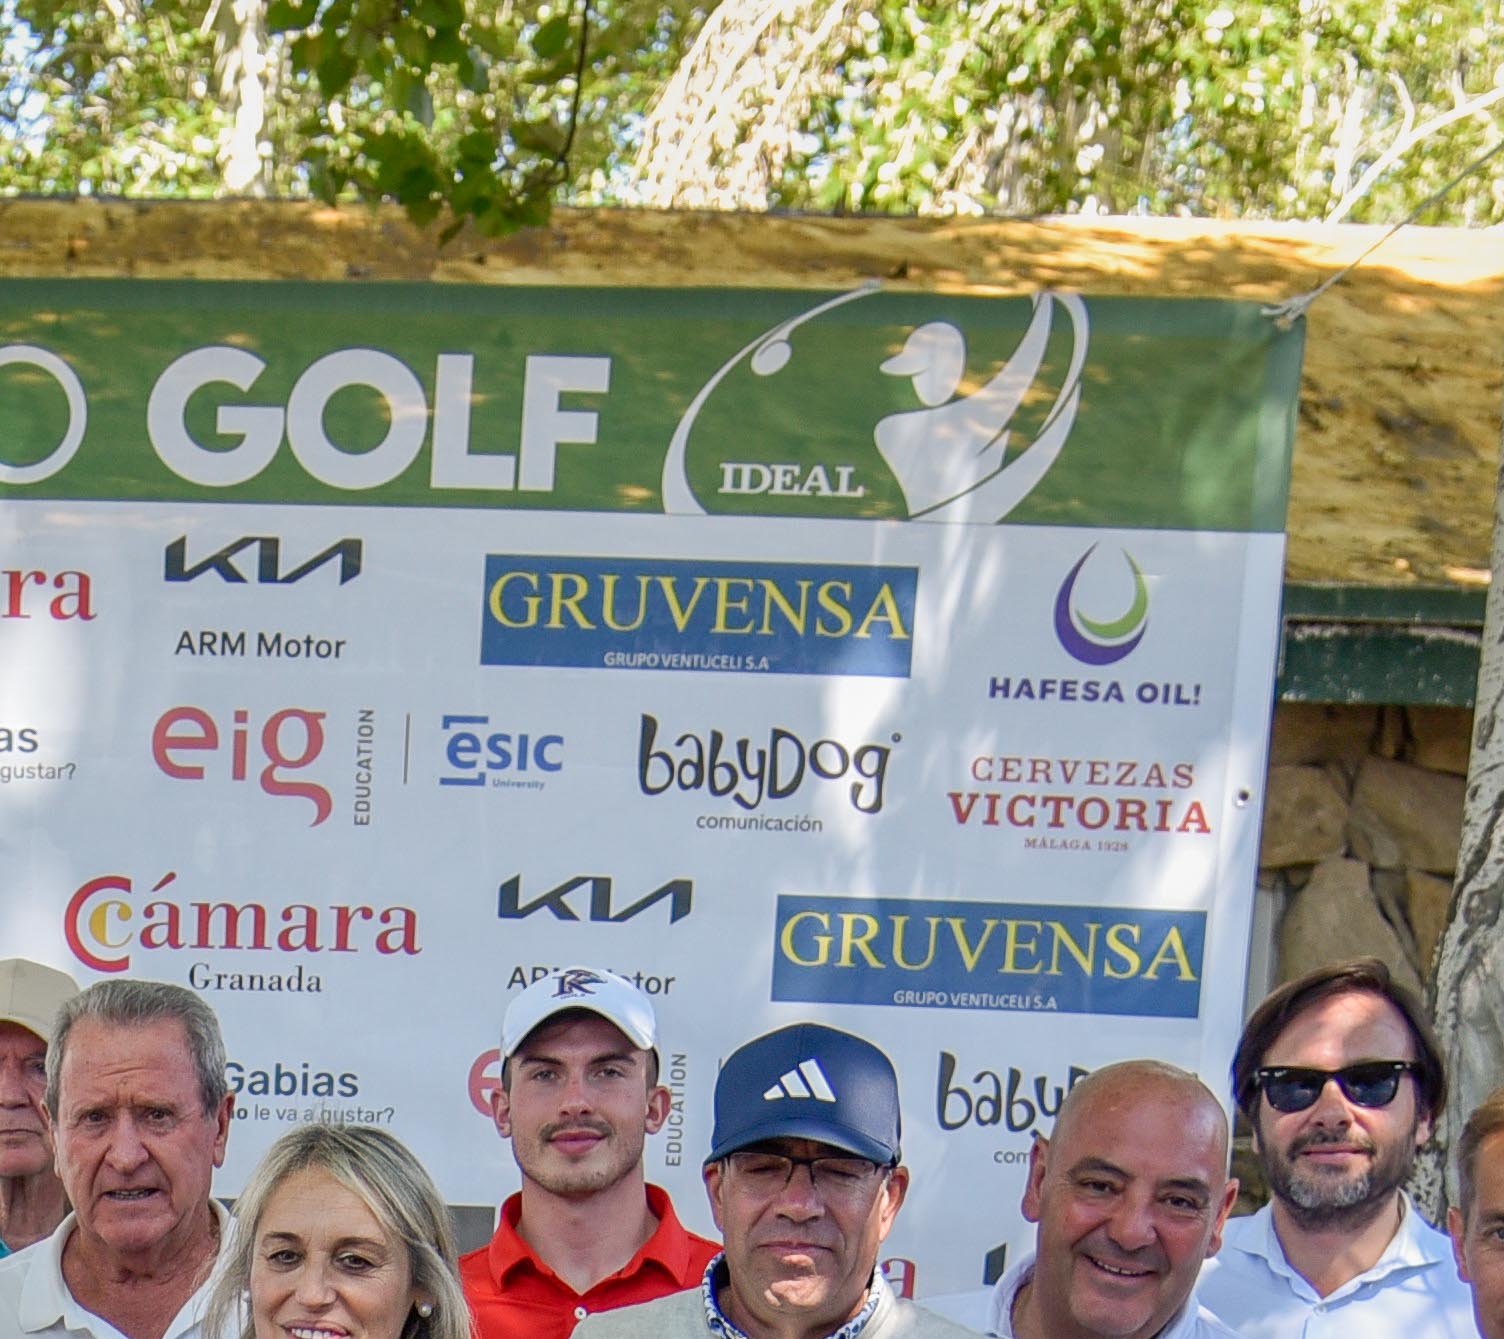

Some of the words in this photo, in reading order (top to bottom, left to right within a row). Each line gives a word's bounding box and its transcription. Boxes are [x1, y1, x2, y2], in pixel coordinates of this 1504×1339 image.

[147, 346, 611, 492] GOLF
[718, 464, 864, 498] IDEAL
[488, 571, 910, 639] GRUVENSA
[174, 630, 249, 658] ARM
[256, 630, 346, 659] Motor
[604, 652, 658, 668] GRUPO
[661, 653, 742, 670] VENTUCELI
[989, 677, 1123, 702] HAFESA
[1137, 682, 1201, 705] OIL!
[0, 762, 76, 783] gustar?
[152, 706, 332, 827] eig
[354, 708, 374, 826] EDUCATION
[972, 757, 1194, 788] CERVEZAS
[492, 777, 545, 791] University
[696, 813, 822, 834] comunicación
[947, 792, 1210, 834] VICTORIA
[1024, 836, 1091, 851] MÁLAGA
[781, 911, 1197, 983] GRUVENSA
[189, 964, 322, 993] Granada
[893, 989, 948, 1006] GRUPO
[951, 992, 1031, 1009] VENTUCELI
[254, 1104, 270, 1120] le
[276, 1108, 297, 1120] va
[304, 1109, 313, 1120] a
[665, 1054, 687, 1166] EDUCATION
